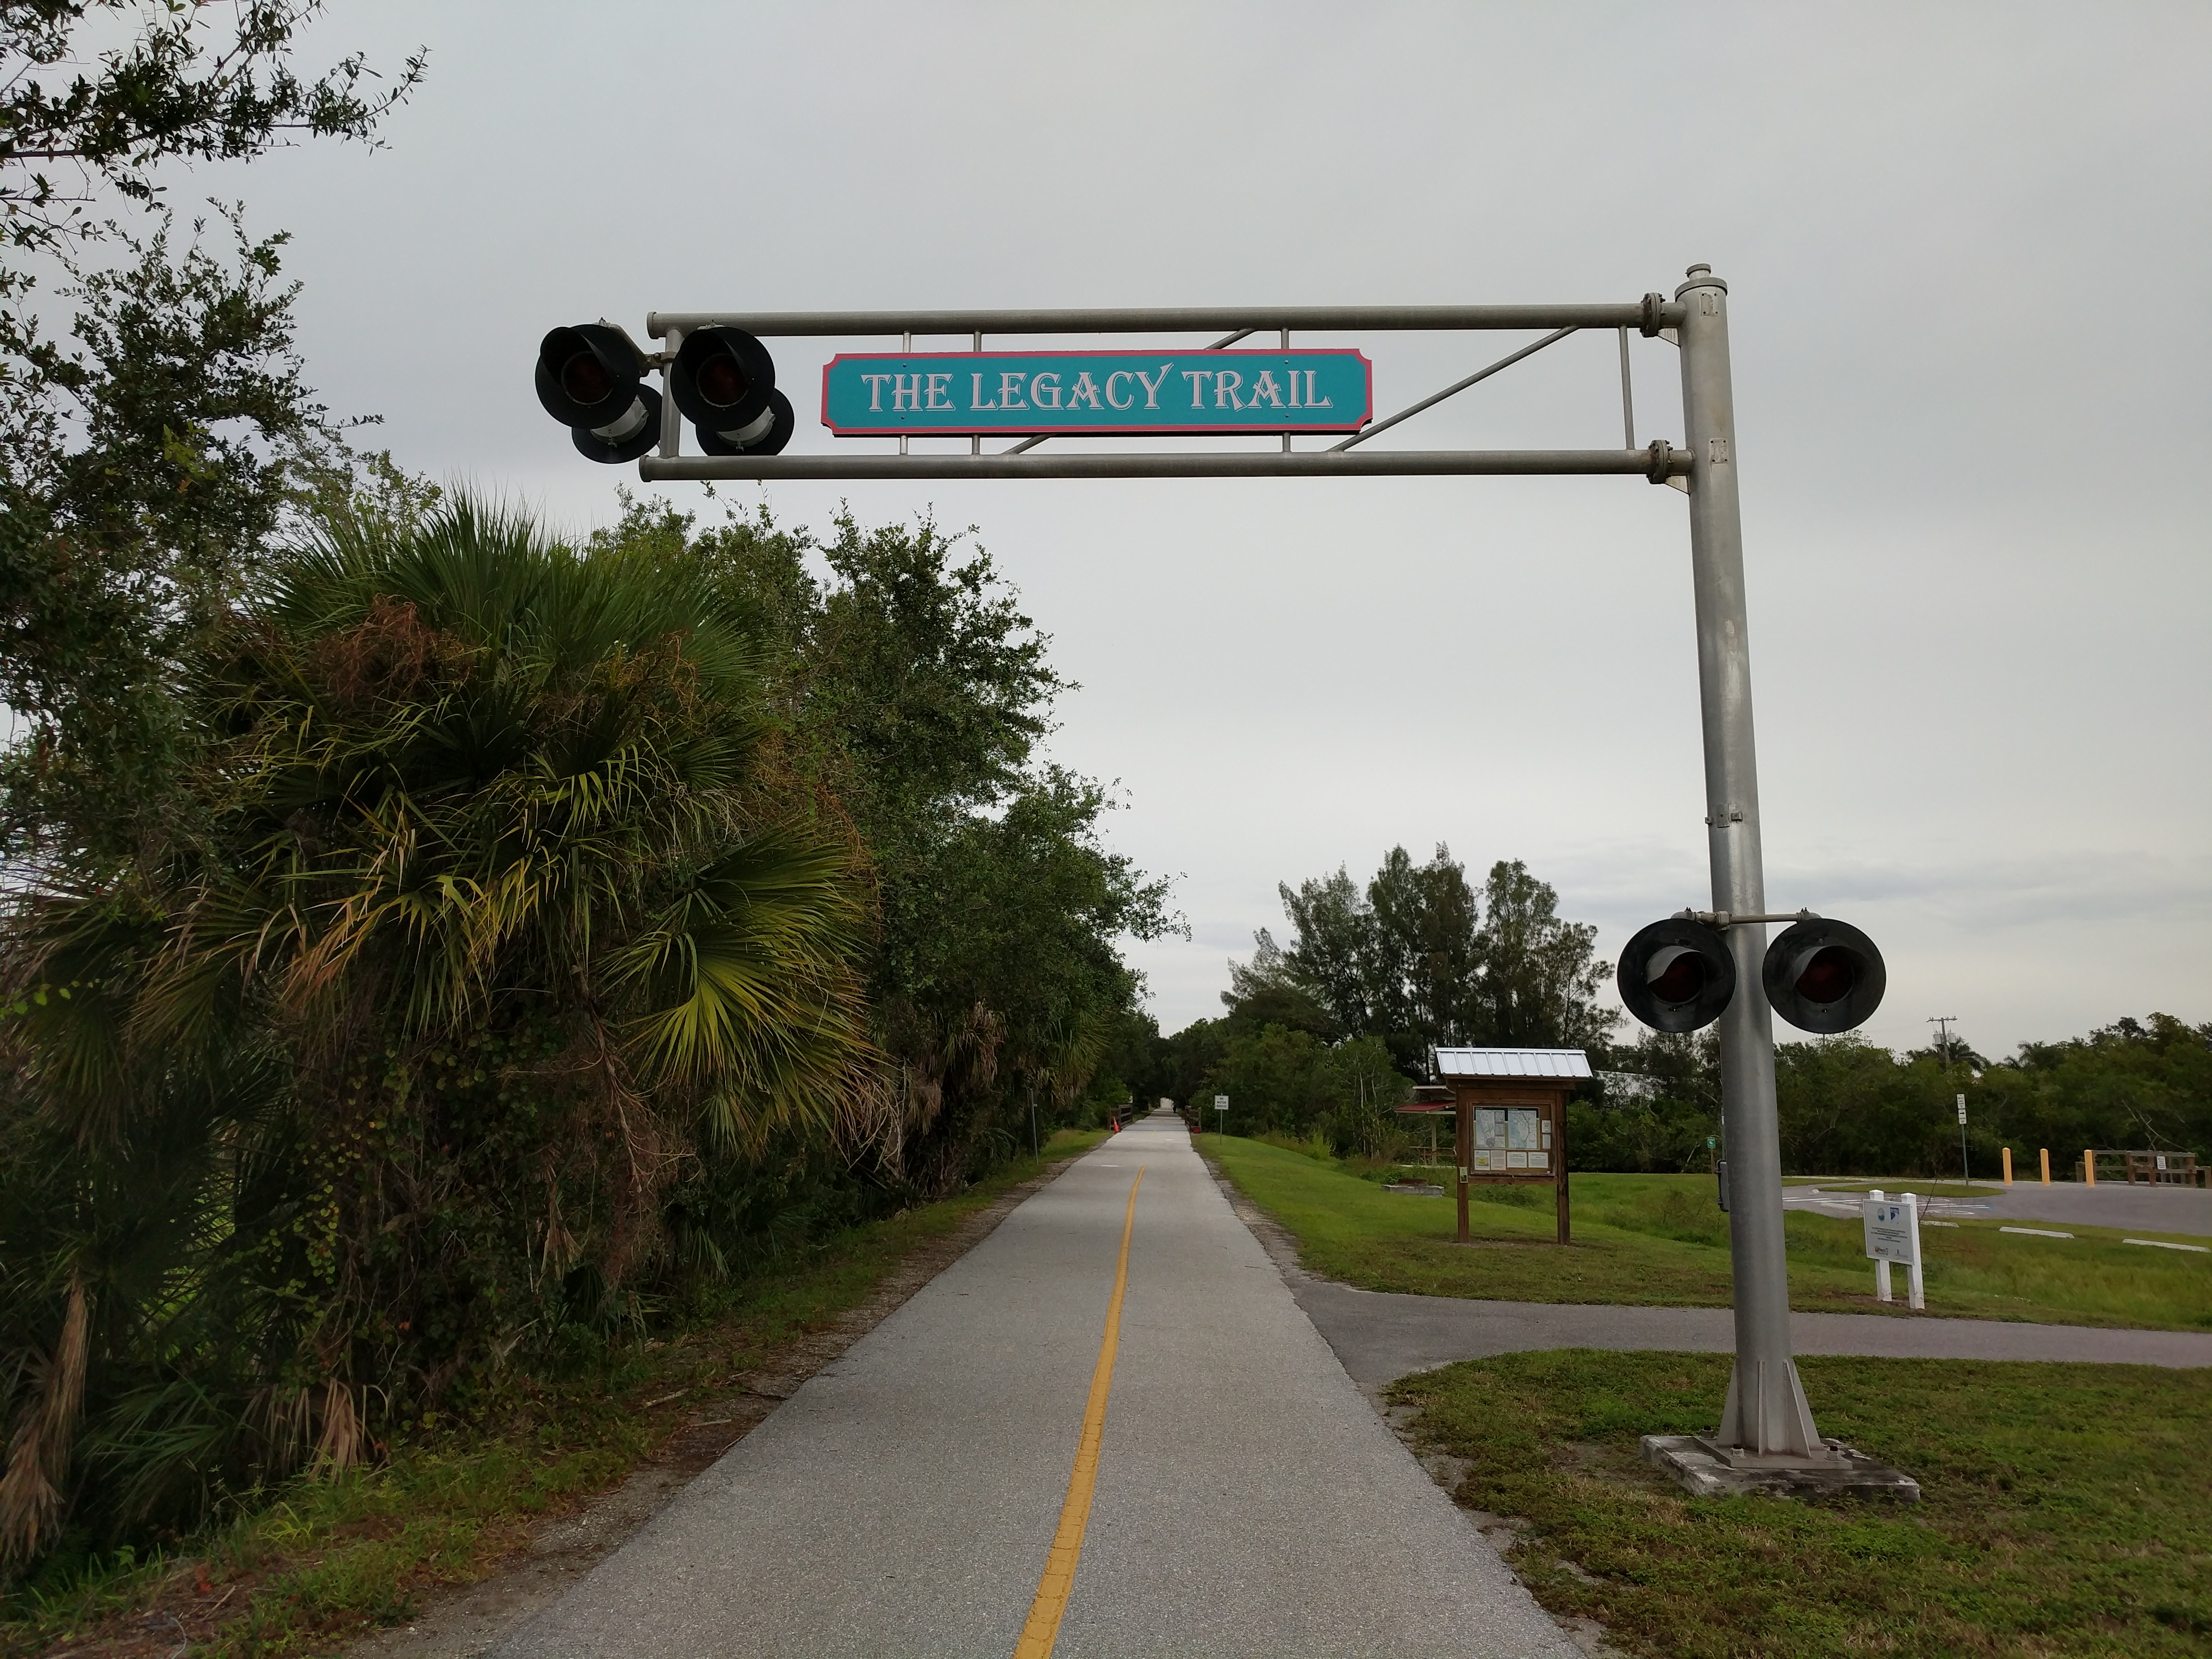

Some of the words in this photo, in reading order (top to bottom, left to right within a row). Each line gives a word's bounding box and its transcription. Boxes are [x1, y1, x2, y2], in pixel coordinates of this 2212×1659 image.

[861, 374, 956, 412] THE
[969, 362, 1174, 411] LEGACY
[1181, 370, 1333, 413] TRAIL
